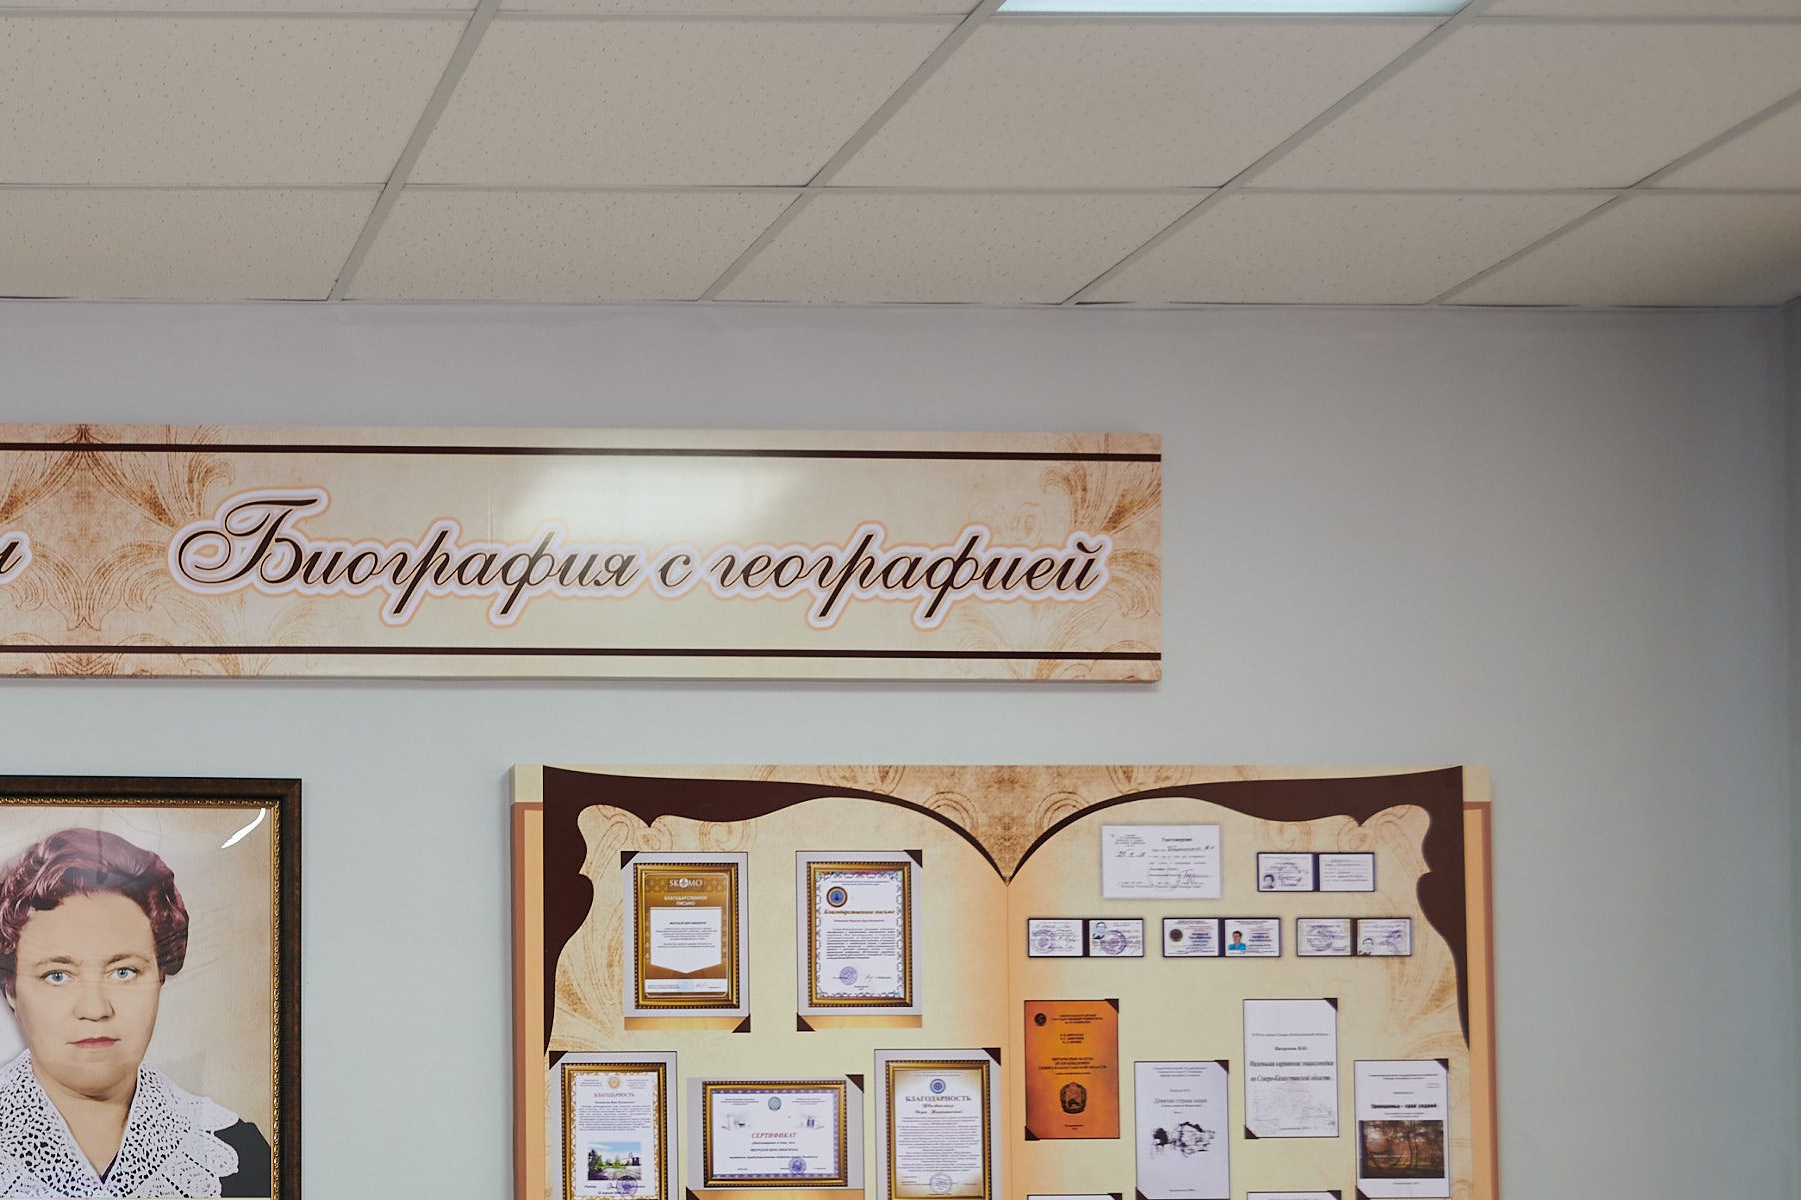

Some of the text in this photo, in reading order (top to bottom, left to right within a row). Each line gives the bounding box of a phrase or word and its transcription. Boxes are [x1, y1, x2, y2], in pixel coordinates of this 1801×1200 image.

[178, 497, 1105, 620] Биография с географией
